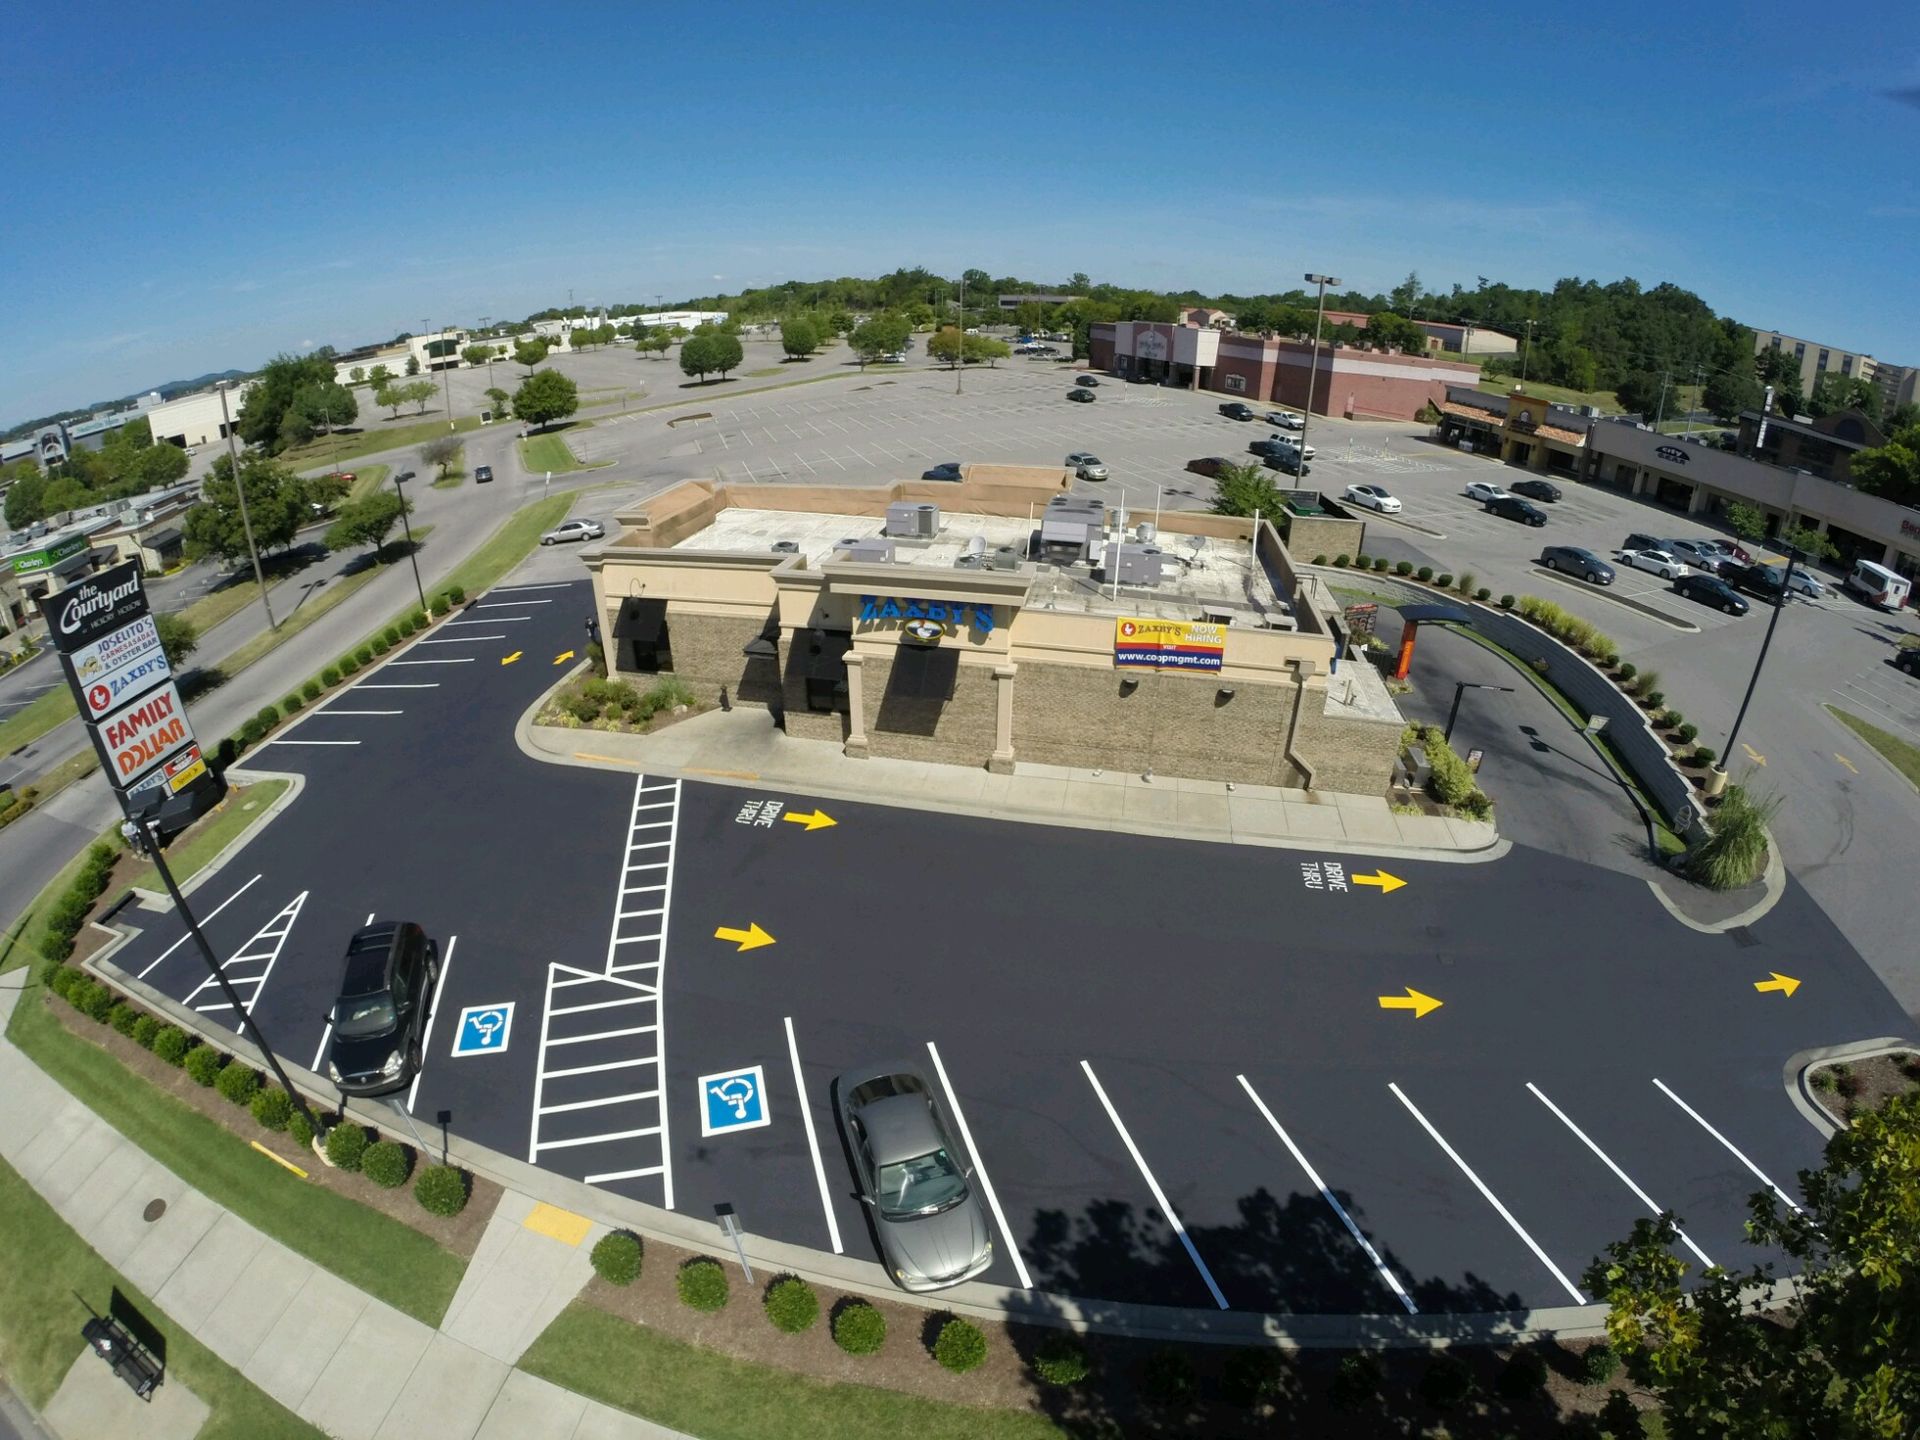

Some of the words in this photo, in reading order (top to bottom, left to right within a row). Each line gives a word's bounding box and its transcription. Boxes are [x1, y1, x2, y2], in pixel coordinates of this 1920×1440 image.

[61, 571, 140, 634] Courtyard
[79, 585, 97, 601] the
[860, 595, 993, 633] ZAXBY'S
[98, 618, 153, 654] JOSELITO'S
[1138, 625, 1182, 636] ZAXBY'S
[1191, 624, 1217, 634] NOW
[112, 645, 141, 666] OYSTER
[142, 637, 158, 650] BAR
[1118, 652, 1220, 666] www.coopmgmt.com
[110, 655, 166, 696] ZAXBY'S
[105, 692, 174, 750] FAMILY
[116, 718, 186, 777] DOLLAR
[735, 801, 764, 824] THRU
[753, 801, 784, 828] DRIVE
[1301, 862, 1324, 889] THRU
[1323, 862, 1348, 892] DRIVE
